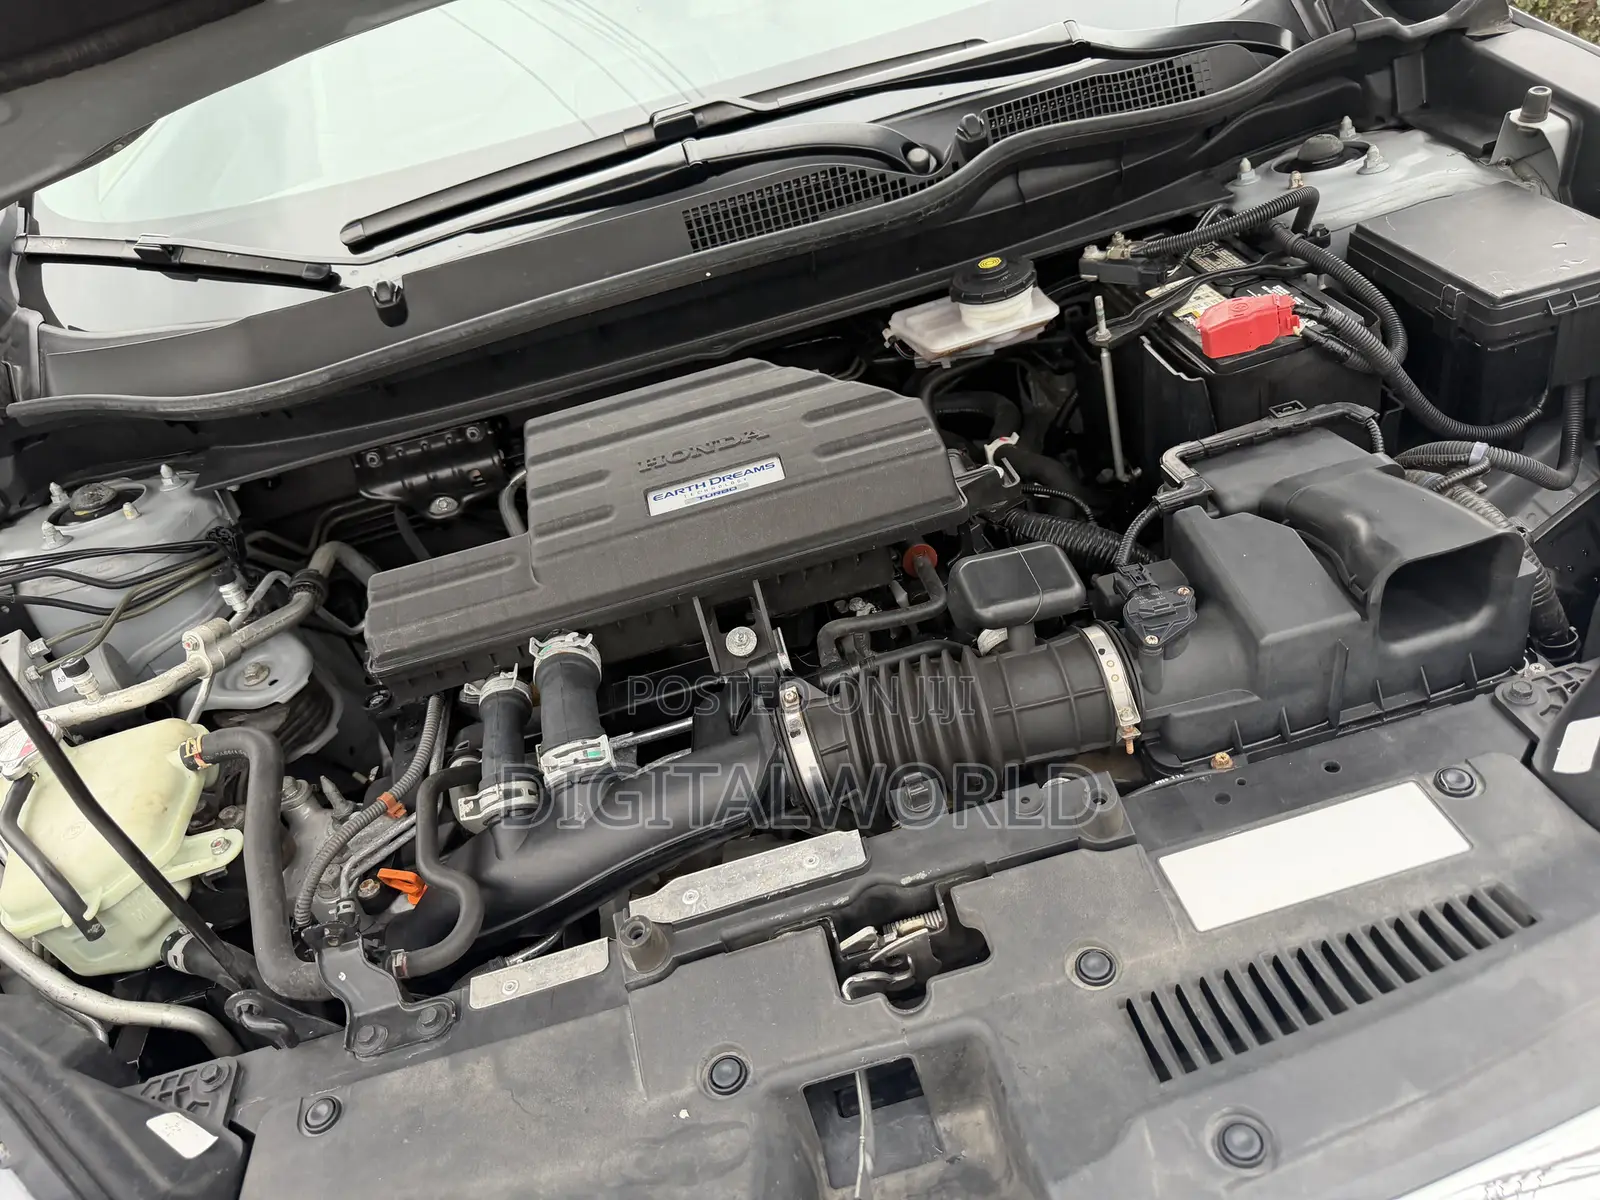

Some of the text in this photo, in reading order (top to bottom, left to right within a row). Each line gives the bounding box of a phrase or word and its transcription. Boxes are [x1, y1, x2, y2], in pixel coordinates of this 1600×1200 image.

[637, 429, 770, 473] HONDA
[653, 462, 775, 501] EARTH DREAMS
[684, 478, 747, 498] TECHNOLOGY
[696, 486, 738, 500] TURBO
